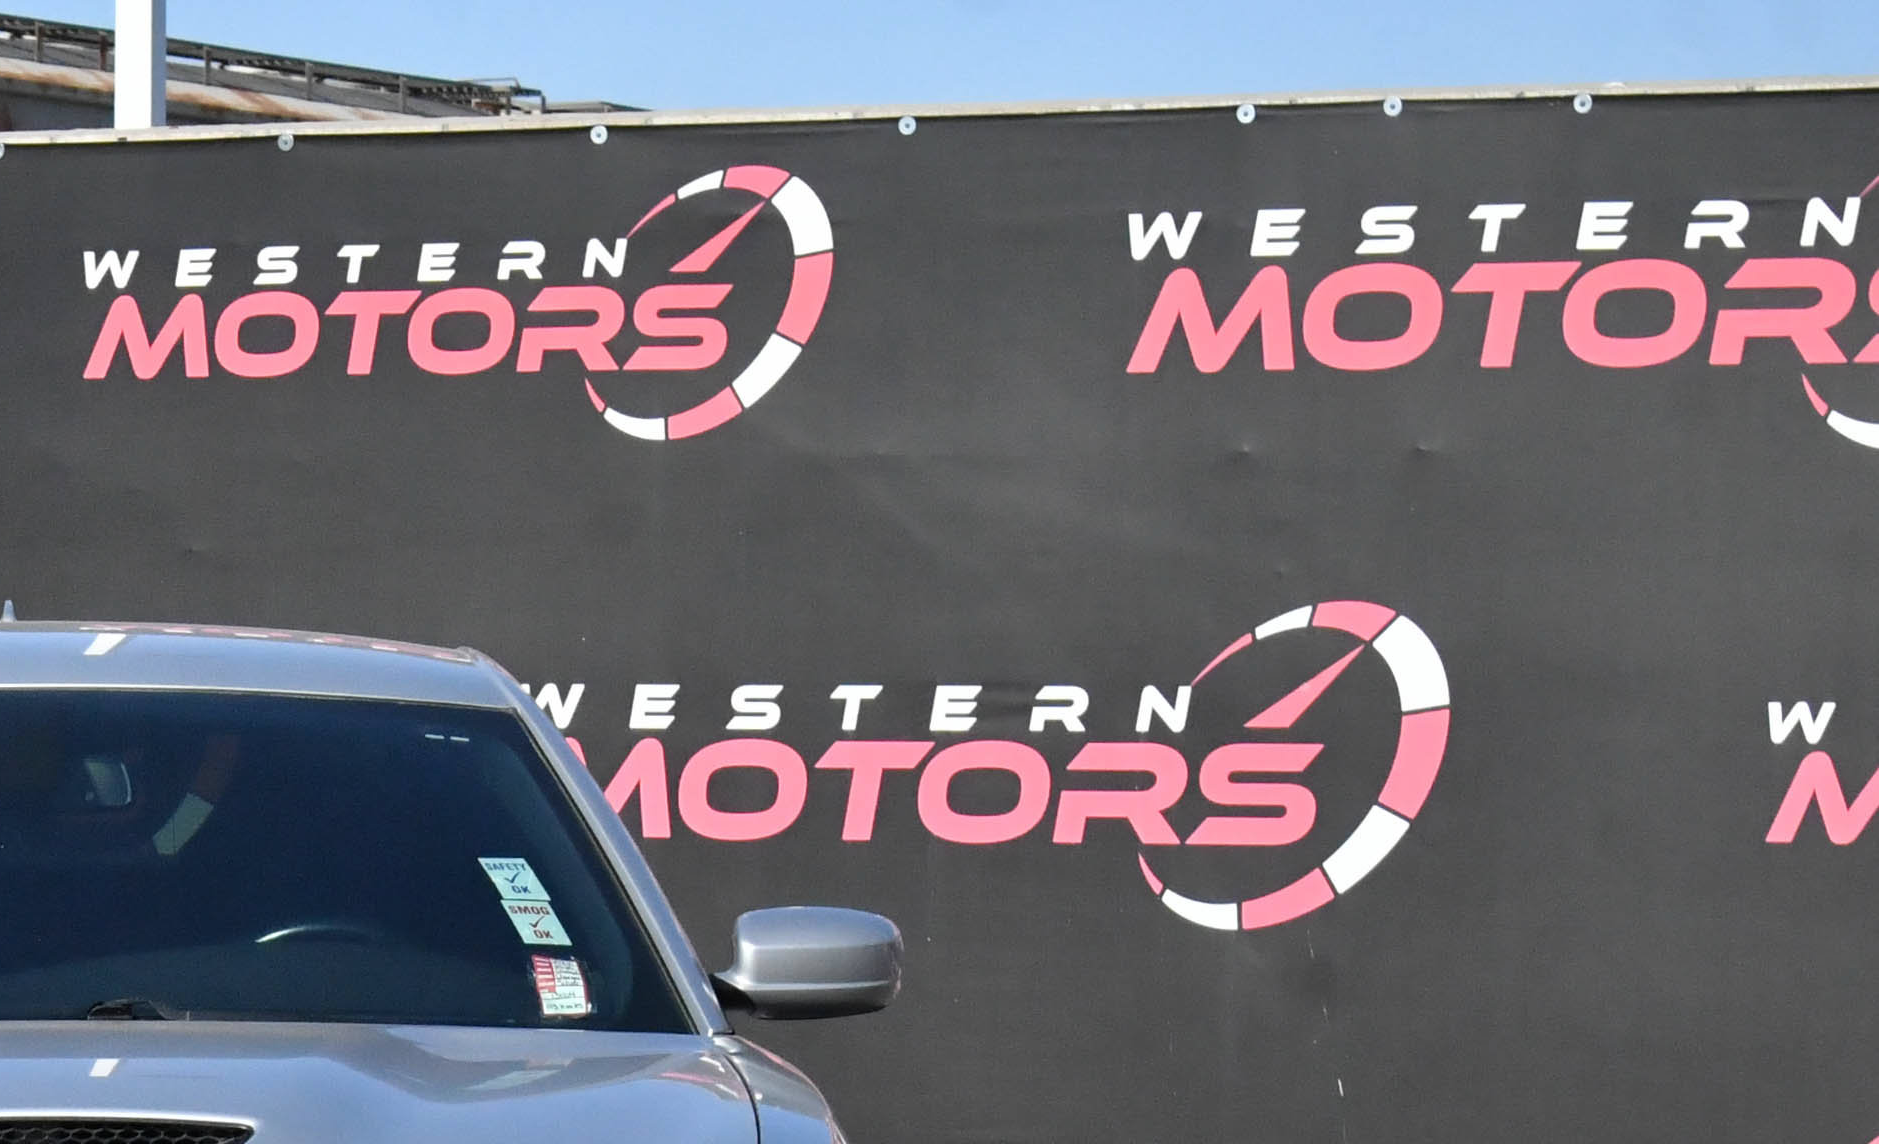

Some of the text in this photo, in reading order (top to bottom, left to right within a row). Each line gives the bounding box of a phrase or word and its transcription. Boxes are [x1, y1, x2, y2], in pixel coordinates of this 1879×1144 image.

[1128, 196, 1862, 261] WESTERN
[83, 237, 629, 290] WESTERN
[83, 283, 734, 381] MOTORS
[1126, 256, 1879, 374] MOTOR
[520, 682, 1192, 733] WESTERN
[483, 862, 527, 872] SAFETY
[511, 884, 532, 895] OK
[507, 904, 551, 916] SMOG
[532, 928, 554, 940] OK
